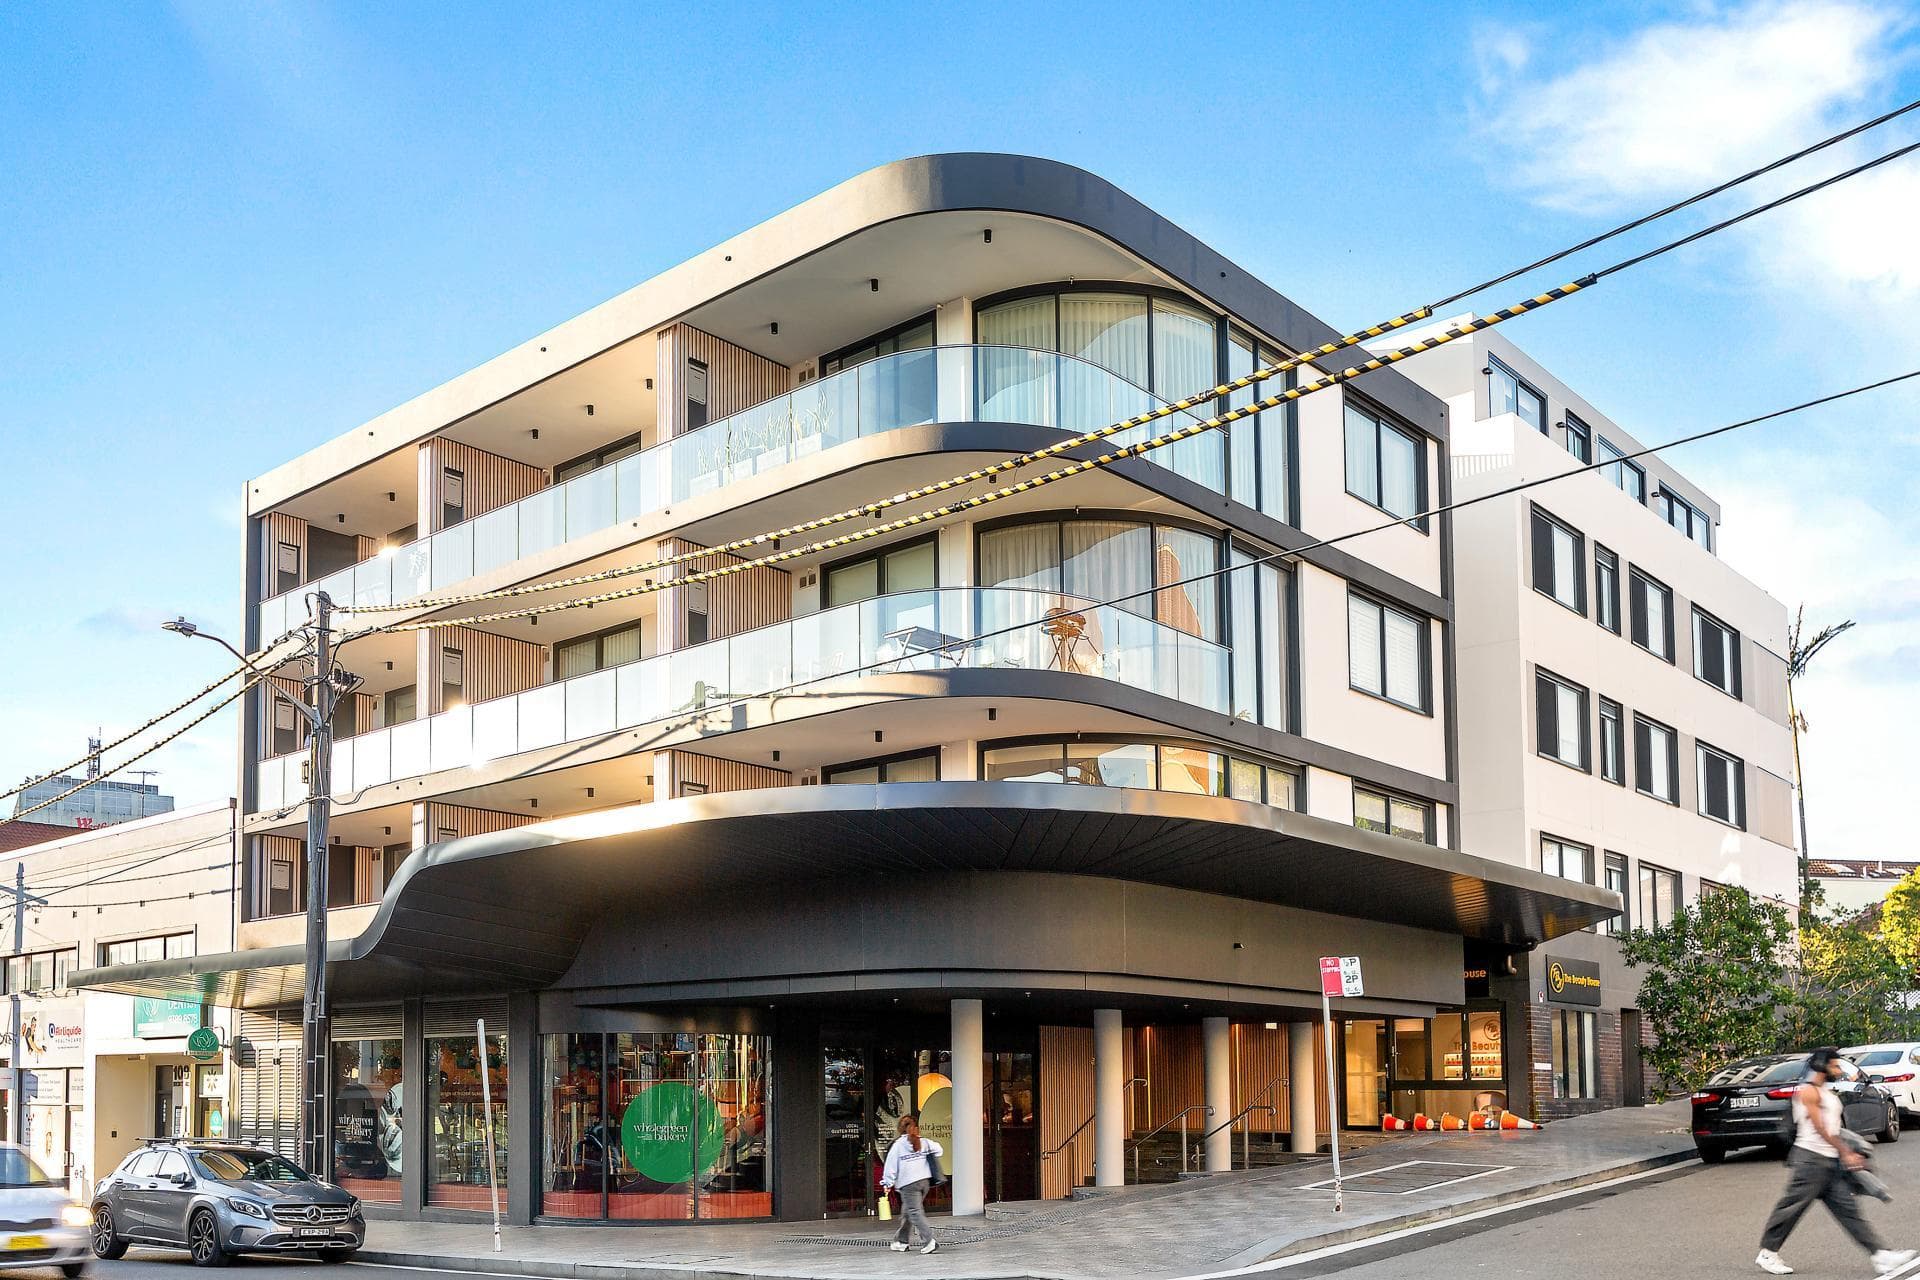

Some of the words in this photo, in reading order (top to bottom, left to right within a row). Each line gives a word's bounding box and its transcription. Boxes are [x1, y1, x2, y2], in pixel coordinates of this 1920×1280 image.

[1325, 959, 1335, 967] NO
[1344, 974, 1359, 984] 2P
[1463, 969, 1487, 979] ouse
[1563, 973, 1572, 984] The
[55, 1026, 63, 1036] Air
[63, 1025, 82, 1037] Liquide
[1472, 1041, 1500, 1051] Beaut
[173, 1065, 190, 1081] 109
[633, 1122, 689, 1135] wholegreen
[654, 1130, 689, 1143] bakery
